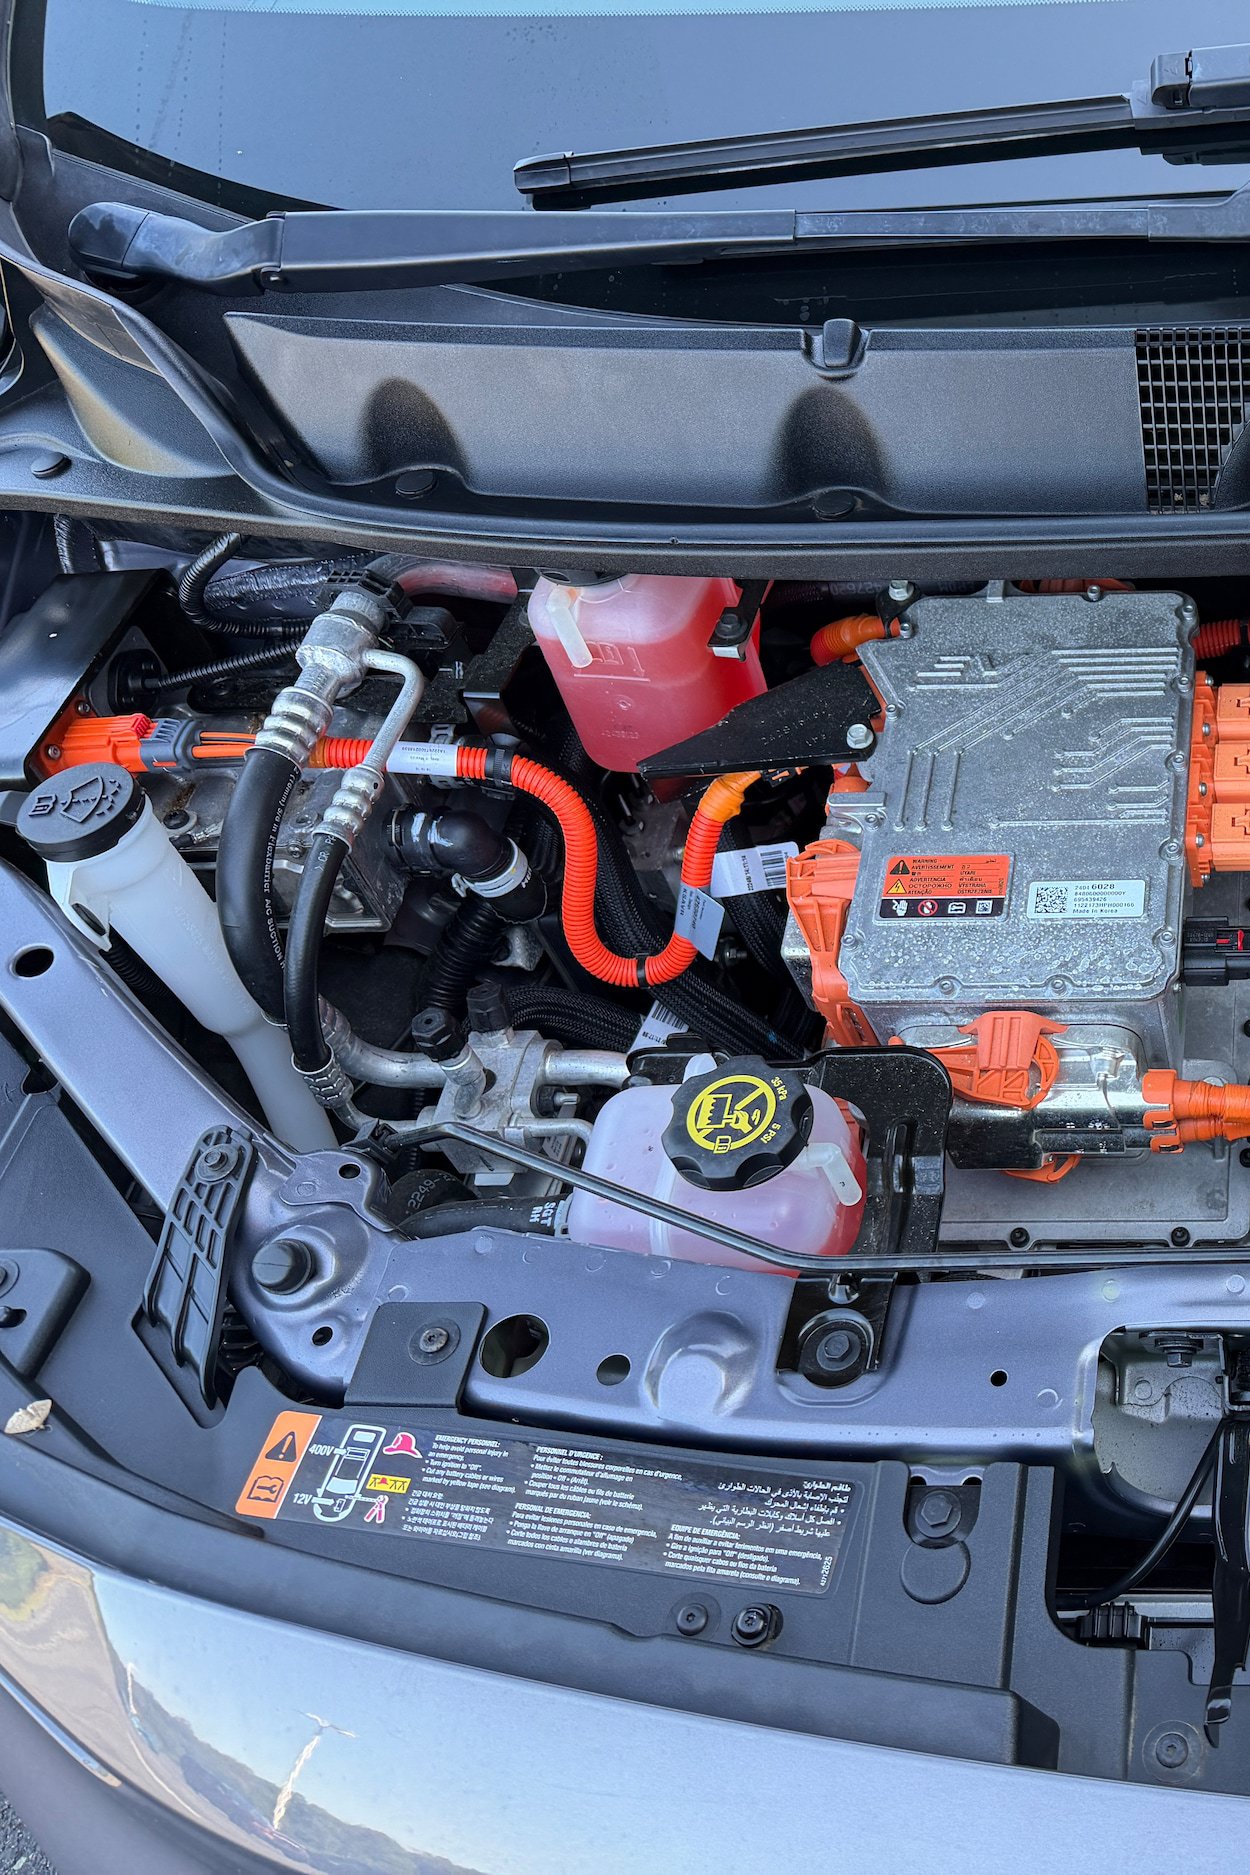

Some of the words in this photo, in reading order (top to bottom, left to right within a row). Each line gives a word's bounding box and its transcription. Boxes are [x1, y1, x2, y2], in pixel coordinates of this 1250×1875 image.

[267, 916, 282, 958] SUCTION
[770, 1076, 783, 1089] 35
[776, 1085, 788, 1101] kPa
[773, 1122, 782, 1131] 5
[760, 1129, 777, 1144] PSI
[434, 1434, 468, 1443] EMERGENCY
[308, 1443, 334, 1457] 400V
[464, 1446, 487, 1455] personal
[486, 1449, 502, 1457] injury
[536, 1445, 569, 1455] PERSONNEL
[440, 1460, 461, 1469] ignition
[561, 1457, 579, 1465] toutes
[578, 1460, 605, 1469] blessures
[444, 1470, 465, 1478] battery
[464, 1472, 482, 1480] cables
[448, 1479, 467, 1487] yellow
[466, 1481, 479, 1489] tape
[292, 1493, 313, 1505] 12V
[514, 1502, 545, 1512] PERSONAL
[670, 1523, 692, 1532] EQUIPE
